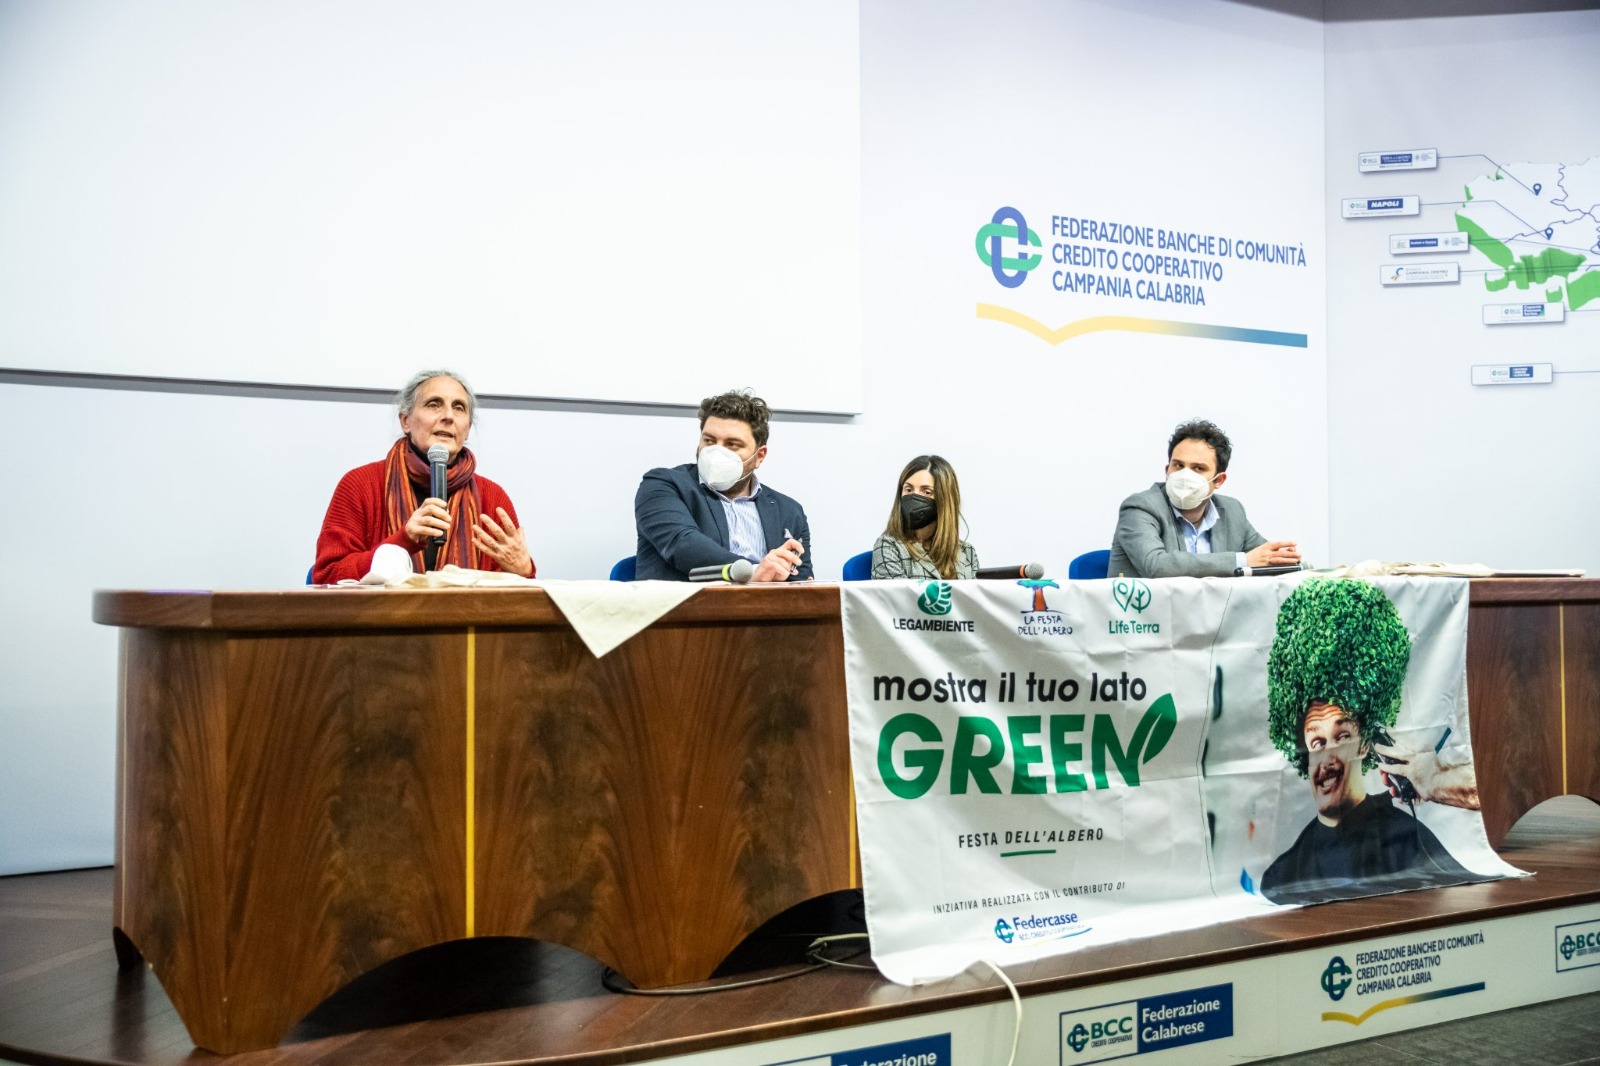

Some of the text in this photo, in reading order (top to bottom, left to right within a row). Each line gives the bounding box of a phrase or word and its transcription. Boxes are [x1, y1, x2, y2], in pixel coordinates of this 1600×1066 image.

[1371, 200, 1400, 208] NAPOLI
[1051, 215, 1306, 267] FEDERAZIONE BANCHE DI COMUNITÀ
[1051, 243, 1223, 282] CREDITO COOPERATIVO
[1052, 270, 1206, 306] CAMPANIA CALABRIA
[893, 618, 975, 633] LEGAMBIENTE
[1024, 615, 1063, 624] LA FESTA
[1108, 620, 1160, 634] Life Terra
[873, 672, 1147, 703] mostra il tuo lato
[877, 693, 1178, 800] GREEN
[959, 828, 1104, 848] FESTA DELL'ALBERO
[933, 881, 1126, 914] INIZIATIVA REALIZZATA CON IL CONTRIBUTO DI
[1013, 913, 1078, 930] Federcasse
[1356, 930, 1485, 965] FEDERAZIONE BANCHE DI COMUNITÀ
[1356, 955, 1441, 980] CREDITO COOPERATIVO
[1357, 971, 1432, 995] CAMPANIA CALABRIA
[1142, 999, 1220, 1023] Federazione
[1091, 1016, 1132, 1039] BCC
[1142, 1021, 1205, 1042] Calabrese
[839, 1052, 937, 1066] azione
